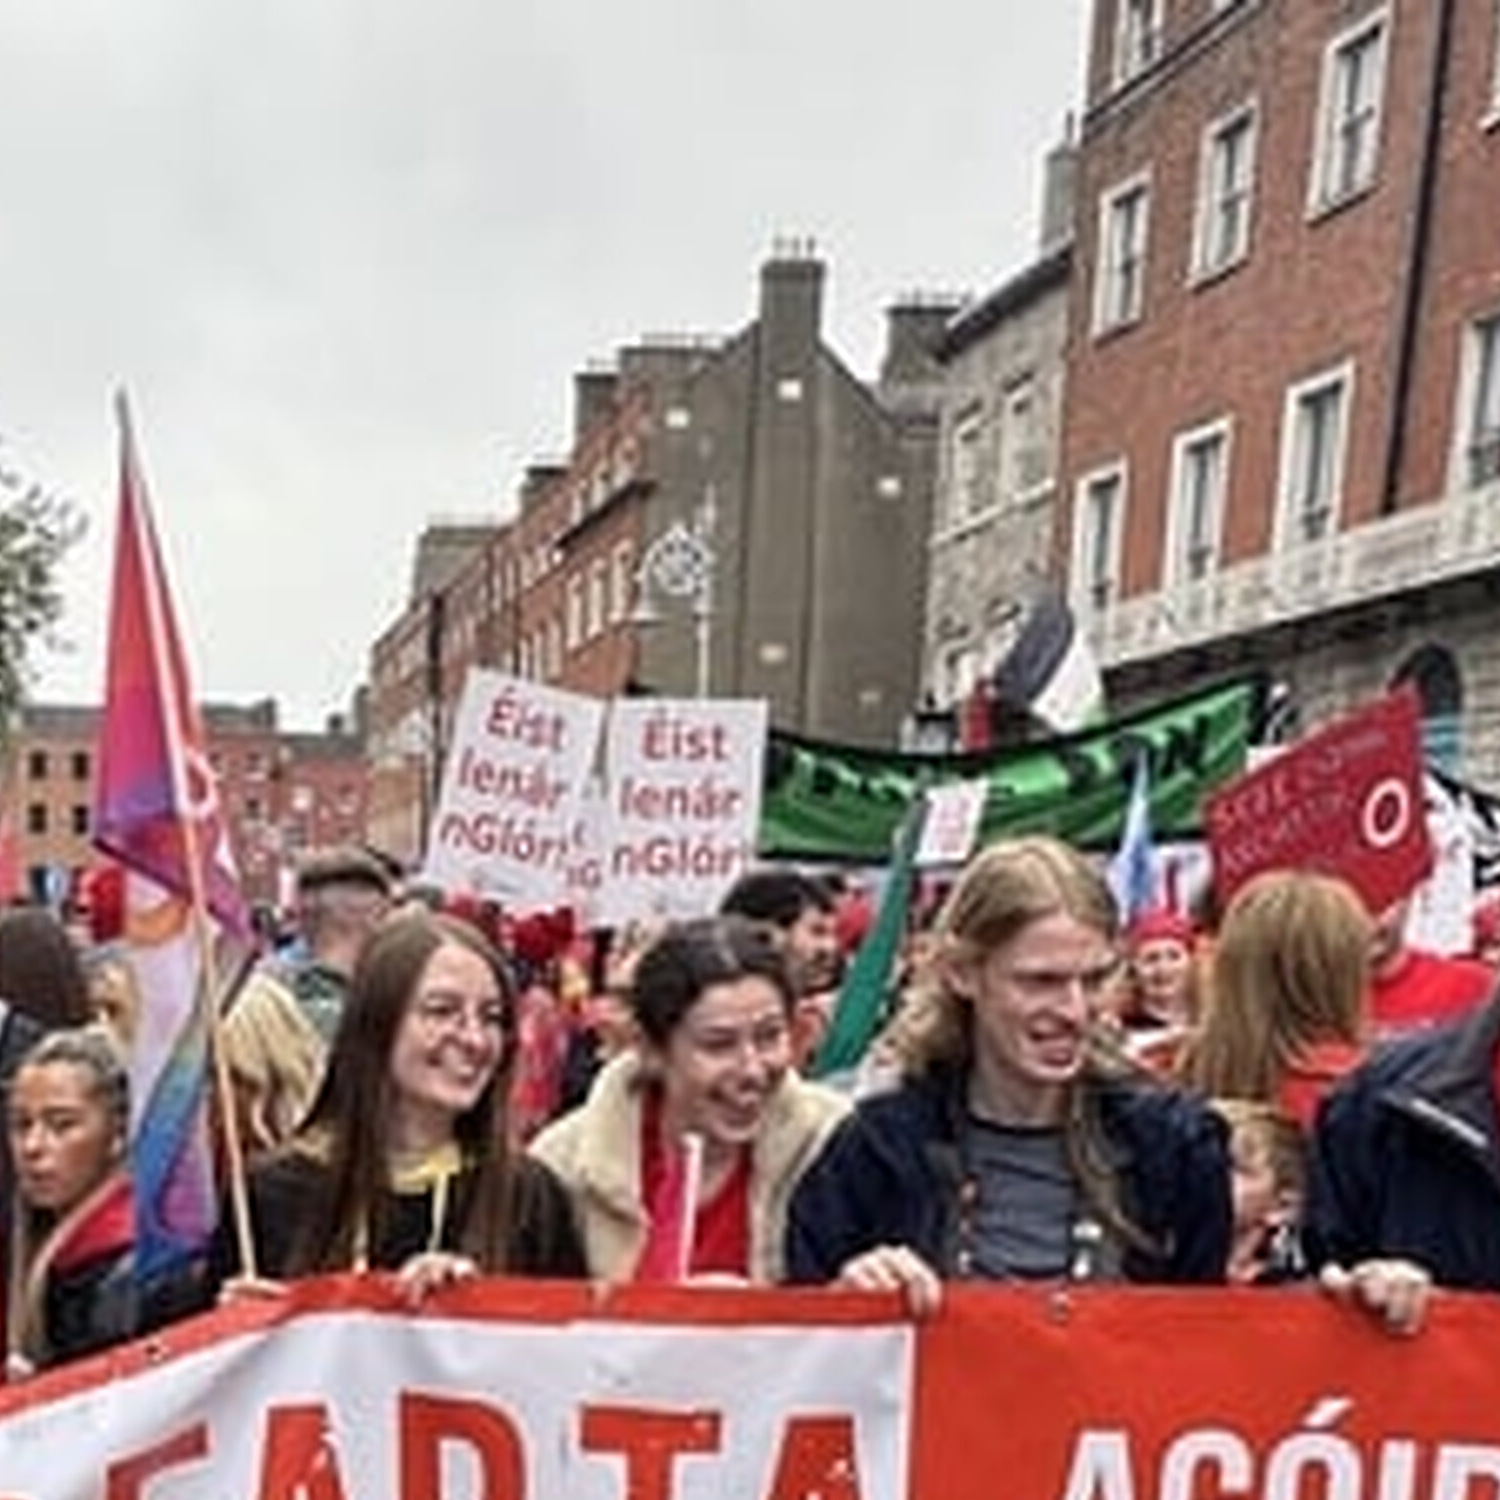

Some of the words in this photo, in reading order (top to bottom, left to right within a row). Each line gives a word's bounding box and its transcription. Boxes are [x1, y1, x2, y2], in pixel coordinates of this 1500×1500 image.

[486, 686, 566, 751] Éist
[640, 708, 729, 761] Éist
[458, 747, 569, 810] lenár
[618, 778, 743, 820] lenár
